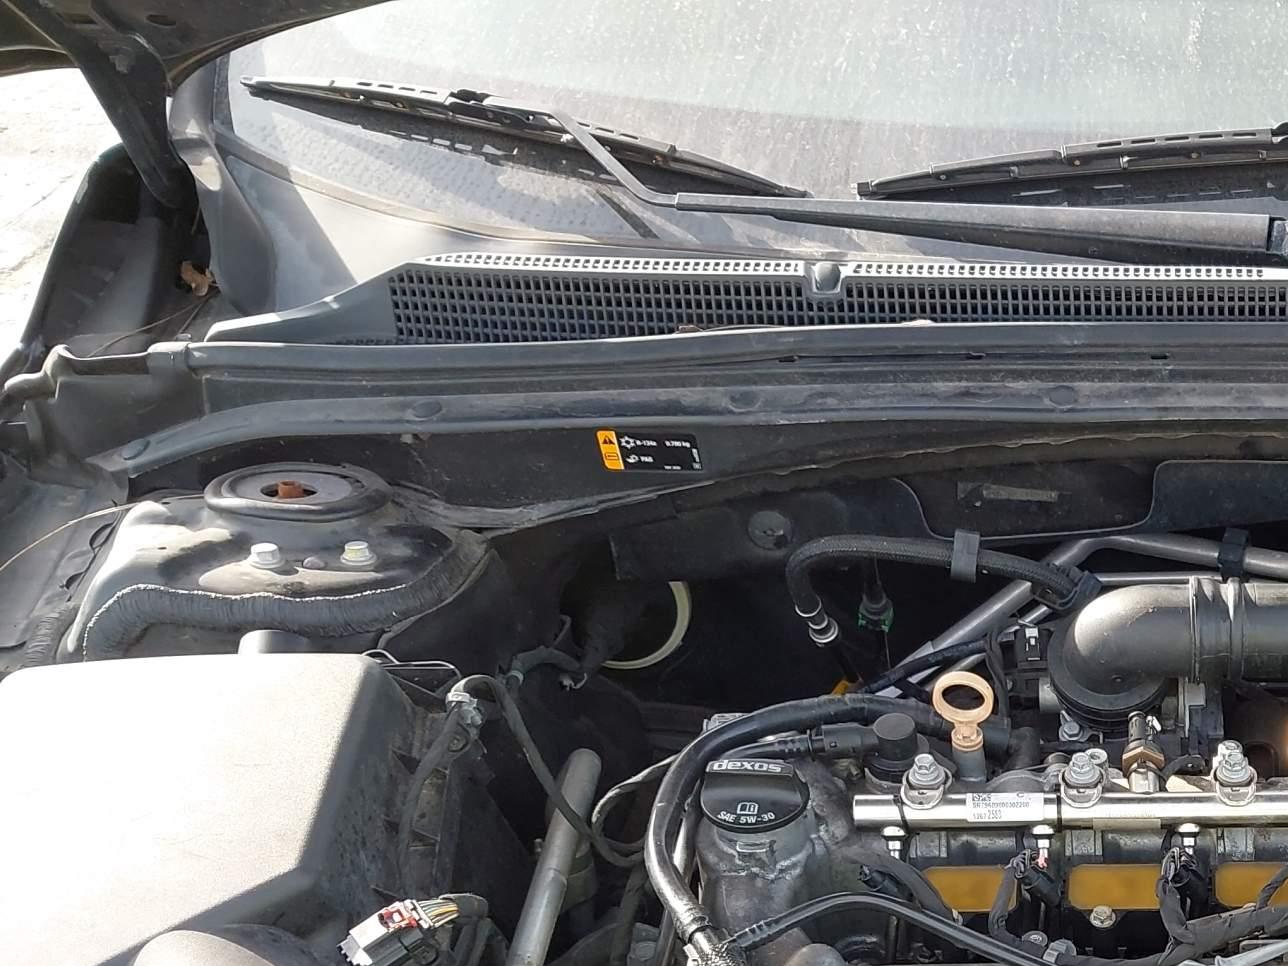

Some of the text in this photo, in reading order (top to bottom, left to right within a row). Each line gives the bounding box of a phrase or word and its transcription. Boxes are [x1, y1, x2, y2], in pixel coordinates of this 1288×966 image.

[713, 760, 783, 773] dexos
[718, 811, 776, 824] SAE 5W-30
